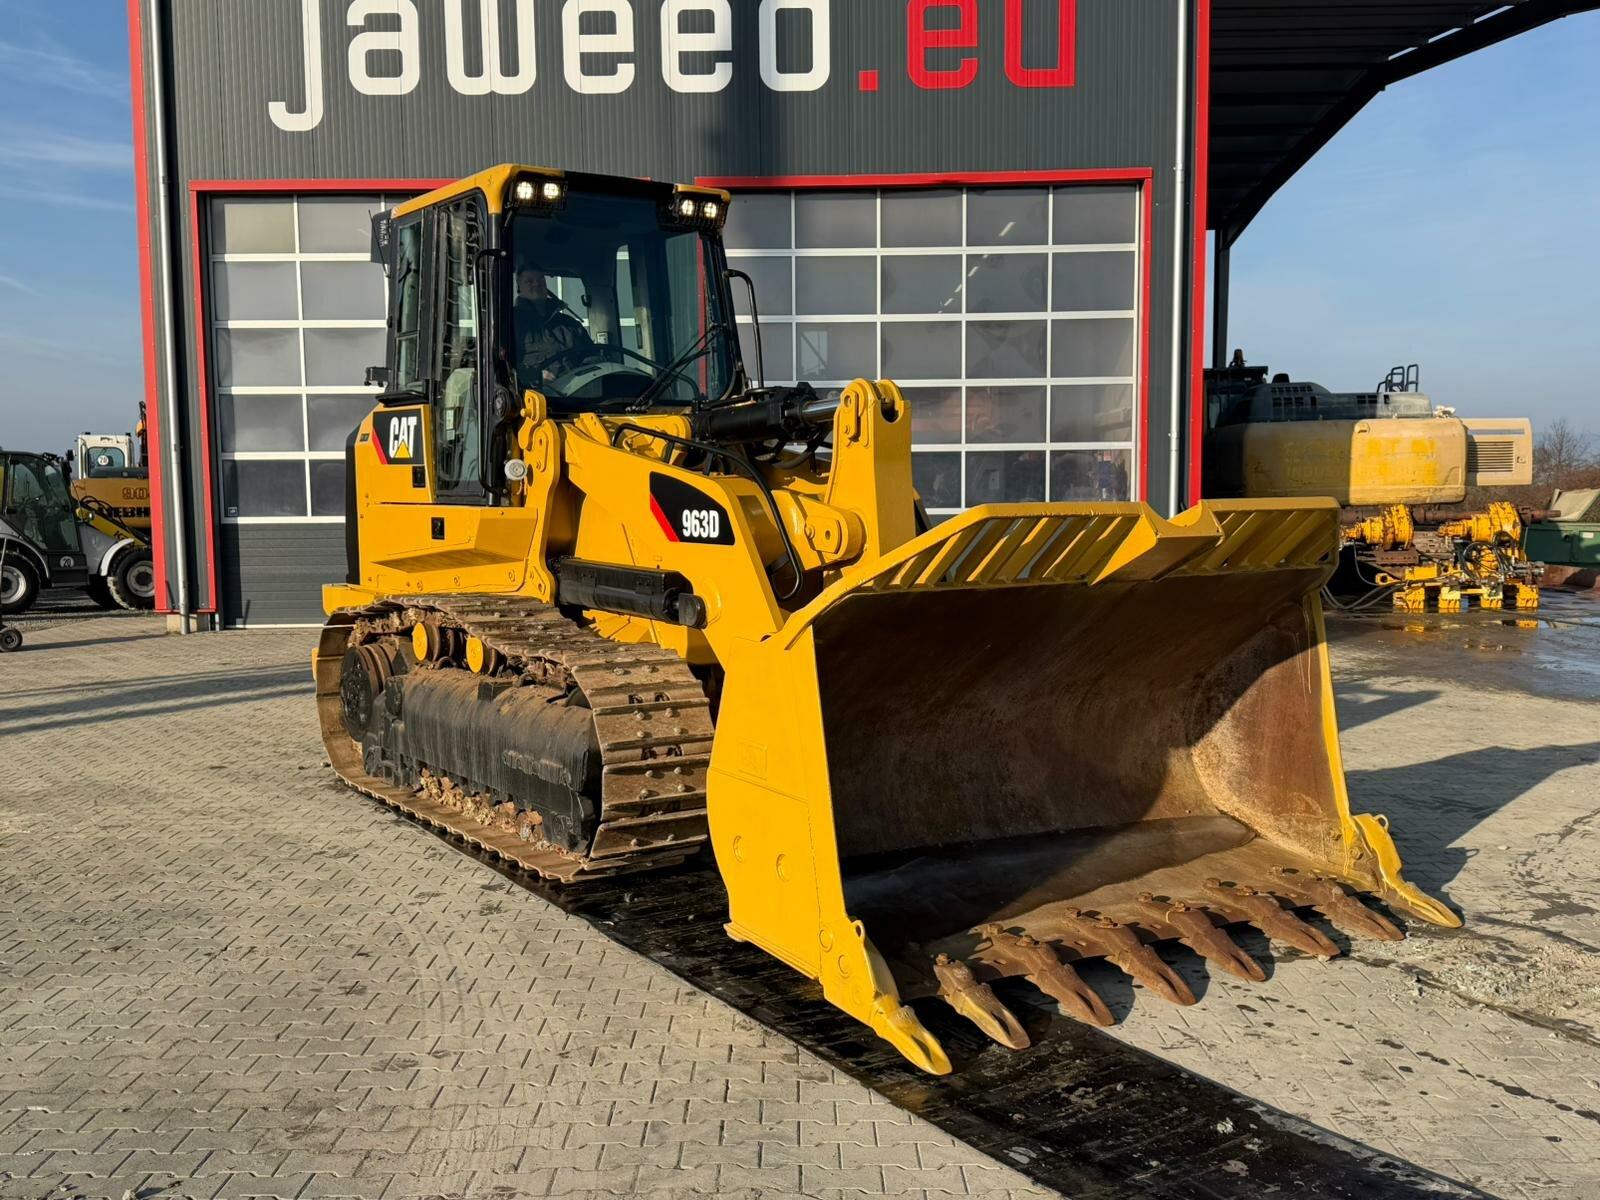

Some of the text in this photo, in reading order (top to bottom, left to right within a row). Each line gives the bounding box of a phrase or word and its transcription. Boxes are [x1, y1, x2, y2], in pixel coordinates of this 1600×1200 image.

[389, 416, 418, 459] CAT
[122, 487, 150, 500] 90
[682, 509, 719, 538] 963D
